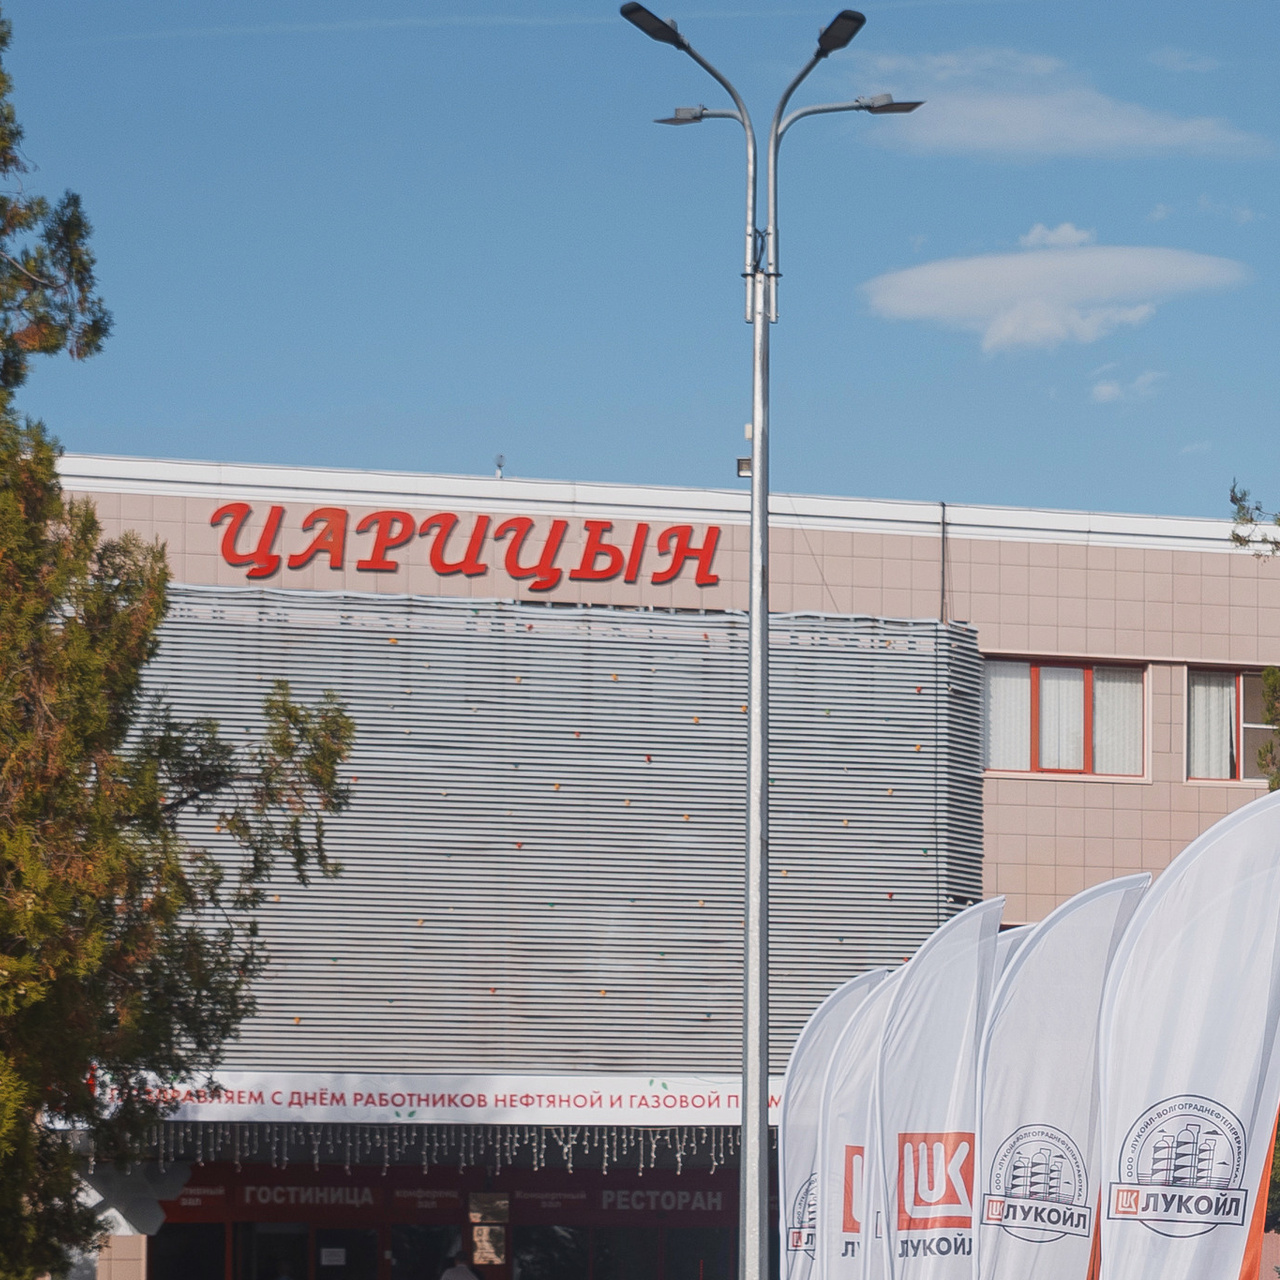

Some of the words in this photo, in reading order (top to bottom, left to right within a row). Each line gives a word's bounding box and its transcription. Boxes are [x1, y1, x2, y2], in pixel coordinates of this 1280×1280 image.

[210, 502, 722, 592] ЦАРИЦЫН
[271, 1090, 283, 1106] С
[288, 1087, 346, 1108] ДНЁМ
[353, 1092, 488, 1108] РАБОТНИКОВ
[494, 1090, 603, 1109] НЕФТЯНОЙ
[609, 1094, 624, 1109] И
[629, 1090, 721, 1109] ГАЗОВОЙ
[244, 1186, 374, 1206] ГОСТИНИЦА
[602, 1190, 724, 1212] РЕСТОРАН
[1141, 1192, 1241, 1217] ЛУКОЙЛ
[1004, 1203, 1087, 1230] ЛУКОЙЛ
